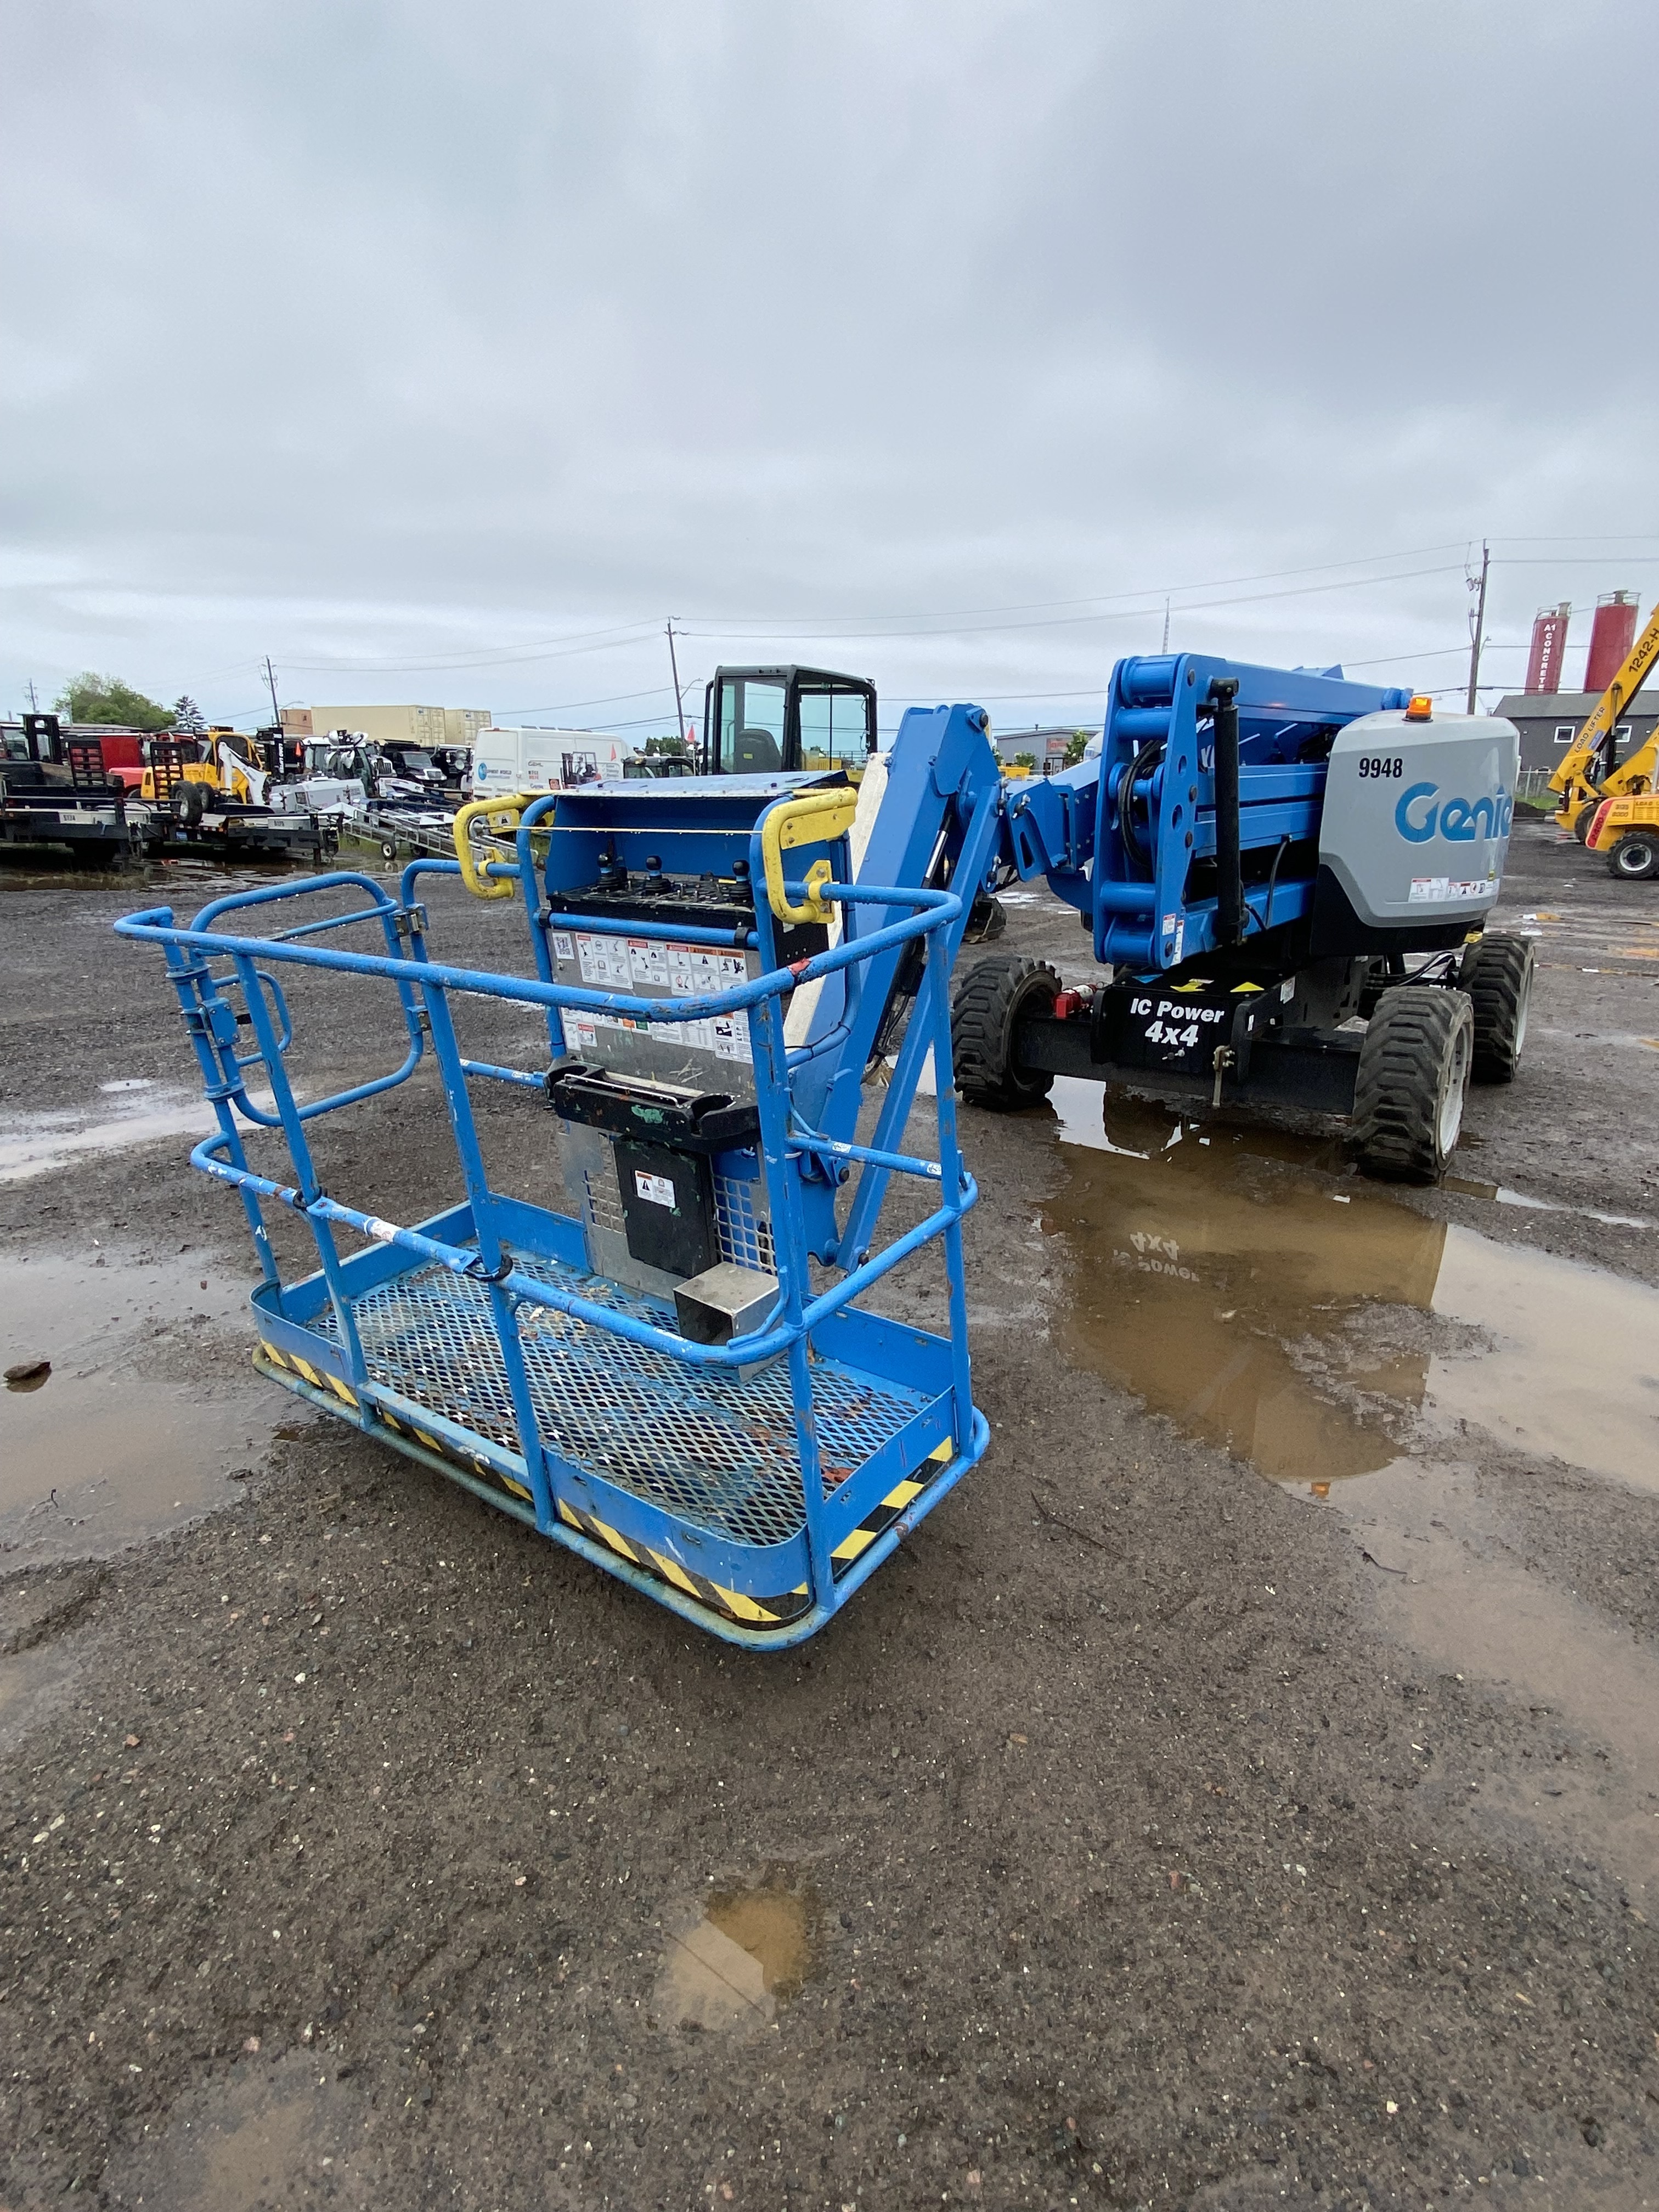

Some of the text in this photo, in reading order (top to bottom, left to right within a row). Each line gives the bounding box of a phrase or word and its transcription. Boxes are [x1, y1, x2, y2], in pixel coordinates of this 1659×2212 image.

[1538, 633, 1553, 691] CONCRETE
[1358, 758, 1403, 778] 9948
[1130, 998, 1224, 1023] IC Power
[1145, 1020, 1199, 1047] 4x4
